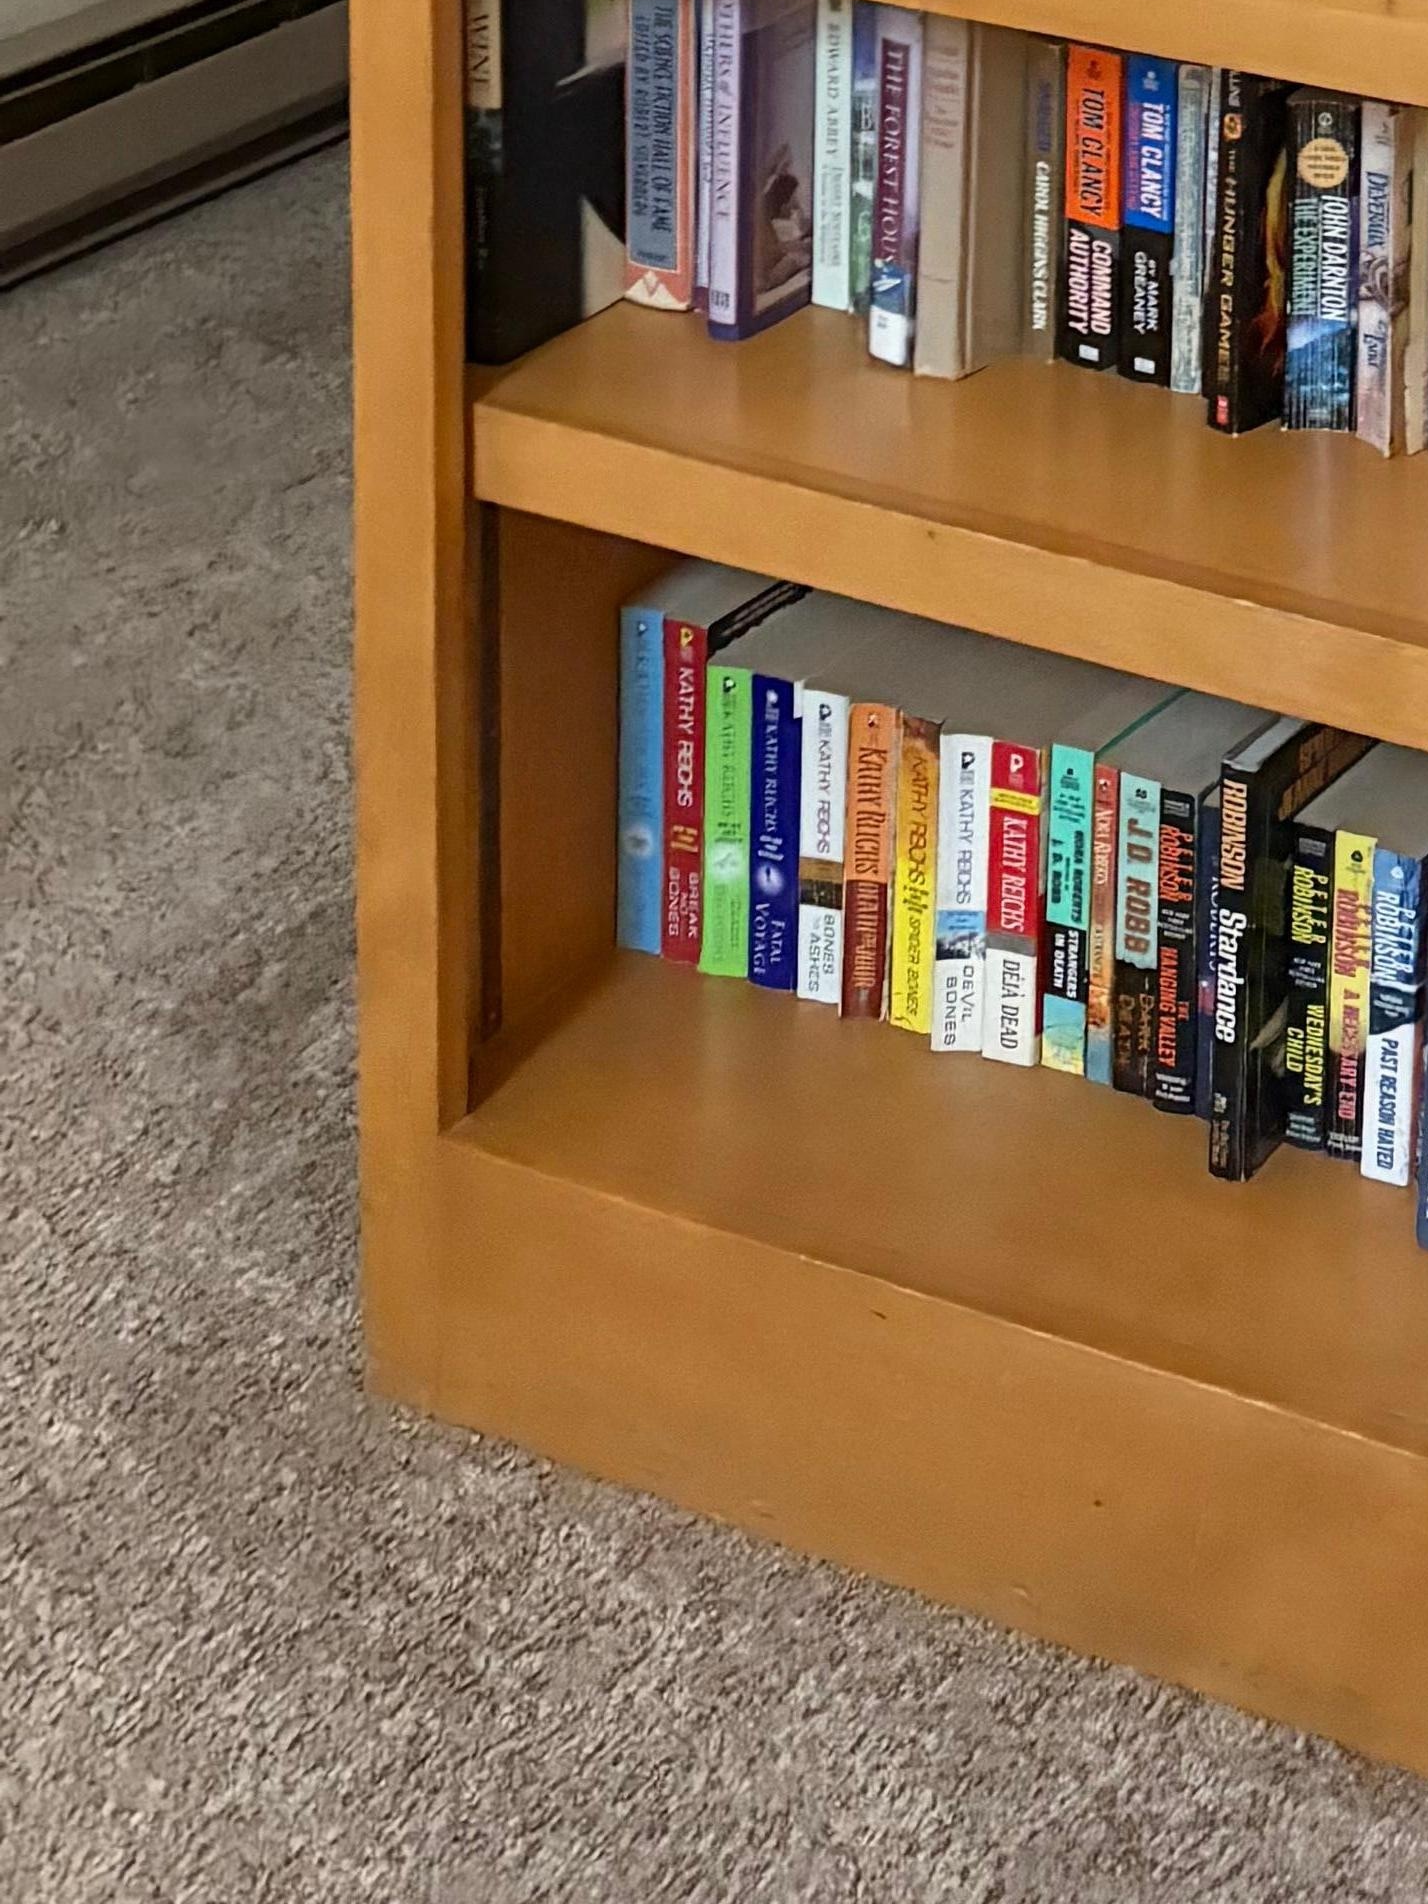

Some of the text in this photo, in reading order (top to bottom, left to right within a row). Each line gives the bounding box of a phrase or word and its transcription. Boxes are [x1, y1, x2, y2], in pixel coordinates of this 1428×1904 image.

[1078, 87, 1105, 218] TOM CLANCY
[1137, 101, 1166, 219] TOM CLANCY
[1068, 227, 1092, 336] AUTHORITY
[1090, 239, 1113, 337] COMMAND
[676, 668, 696, 807] KATHY REICHS
[816, 738, 831, 854] KATHY REICHS
[1221, 777, 1247, 892] ROBINSON
[667, 867, 680, 937] BONES
[686, 870, 699, 939] BREAK
[1123, 878, 1153, 957] ROBB
[1290, 864, 1314, 946] ROBINSON
[770, 919, 784, 966] FATAL
[808, 931, 820, 992] ASHES
[822, 914, 835, 976] BONES
[1052, 950, 1065, 989] DEATH
[1066, 929, 1078, 999] STRANGERS
[1214, 908, 1247, 1044] Stardance
[944, 976, 958, 1047] BONES
[960, 964, 975, 1023] DEVIL
[1285, 1026, 1303, 1074] CHILD
[1303, 1004, 1325, 1107] WEDNESDAY'S
